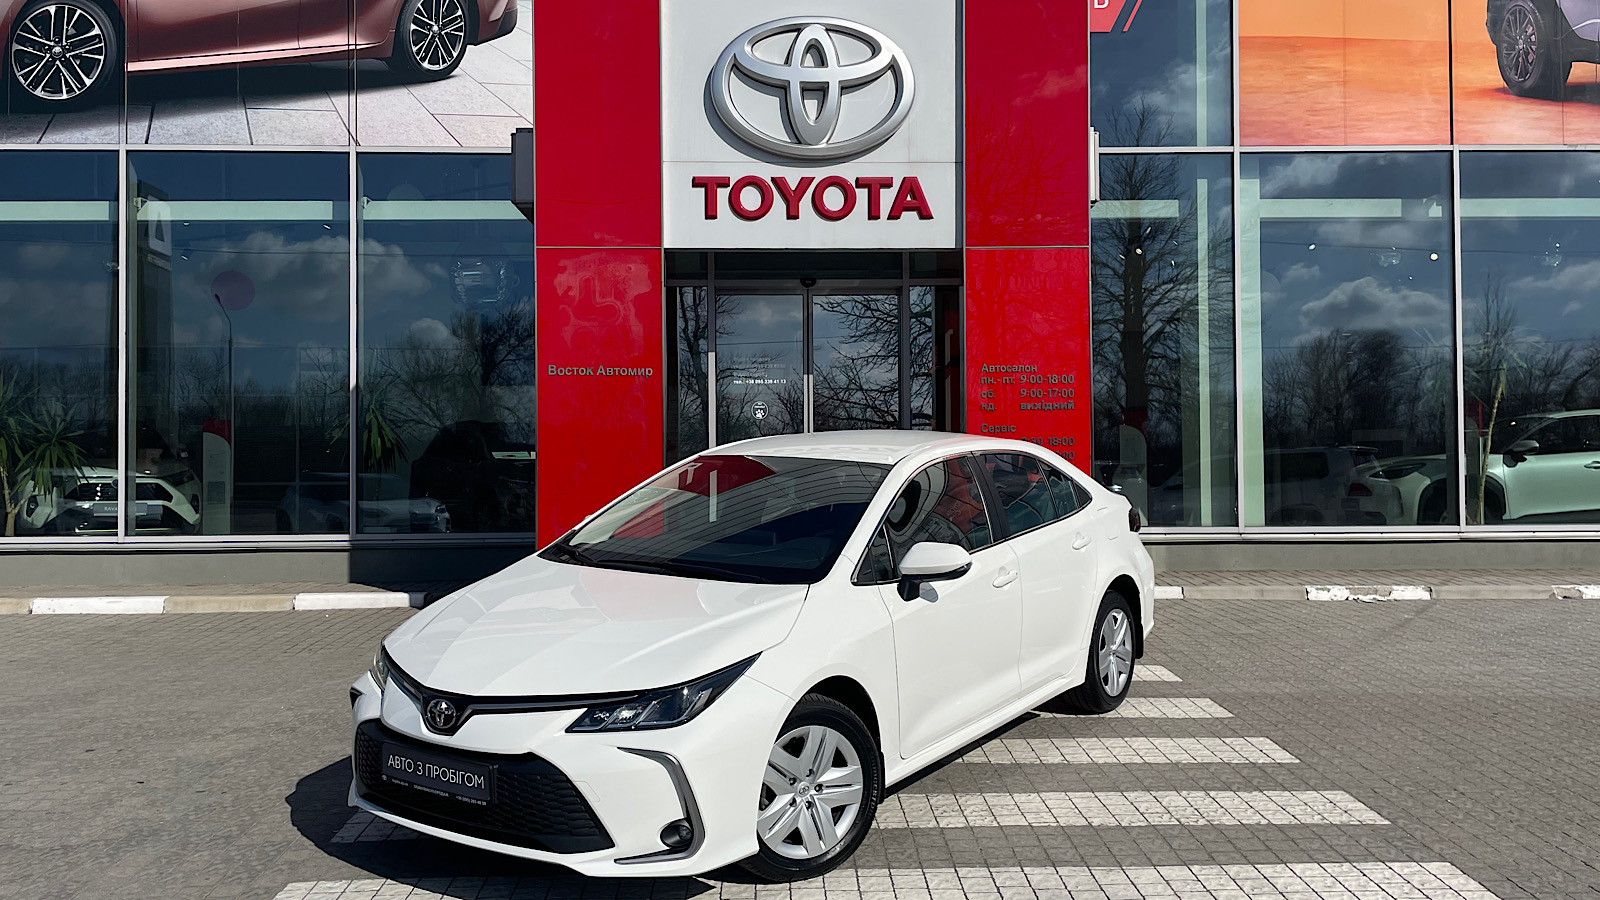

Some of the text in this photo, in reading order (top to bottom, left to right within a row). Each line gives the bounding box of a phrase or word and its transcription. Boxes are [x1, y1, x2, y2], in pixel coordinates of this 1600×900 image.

[692, 175, 934, 221] TOYOTA
[548, 365, 653, 378] Восток Автомир
[981, 363, 1038, 373] Автосалон
[980, 389, 1075, 399] сб. 9:00-17:00
[980, 400, 1075, 412] нд. вихідний
[981, 423, 1016, 435] Сервіс
[388, 754, 414, 773] АВТО
[425, 763, 485, 789] ПРОБІГОМ
